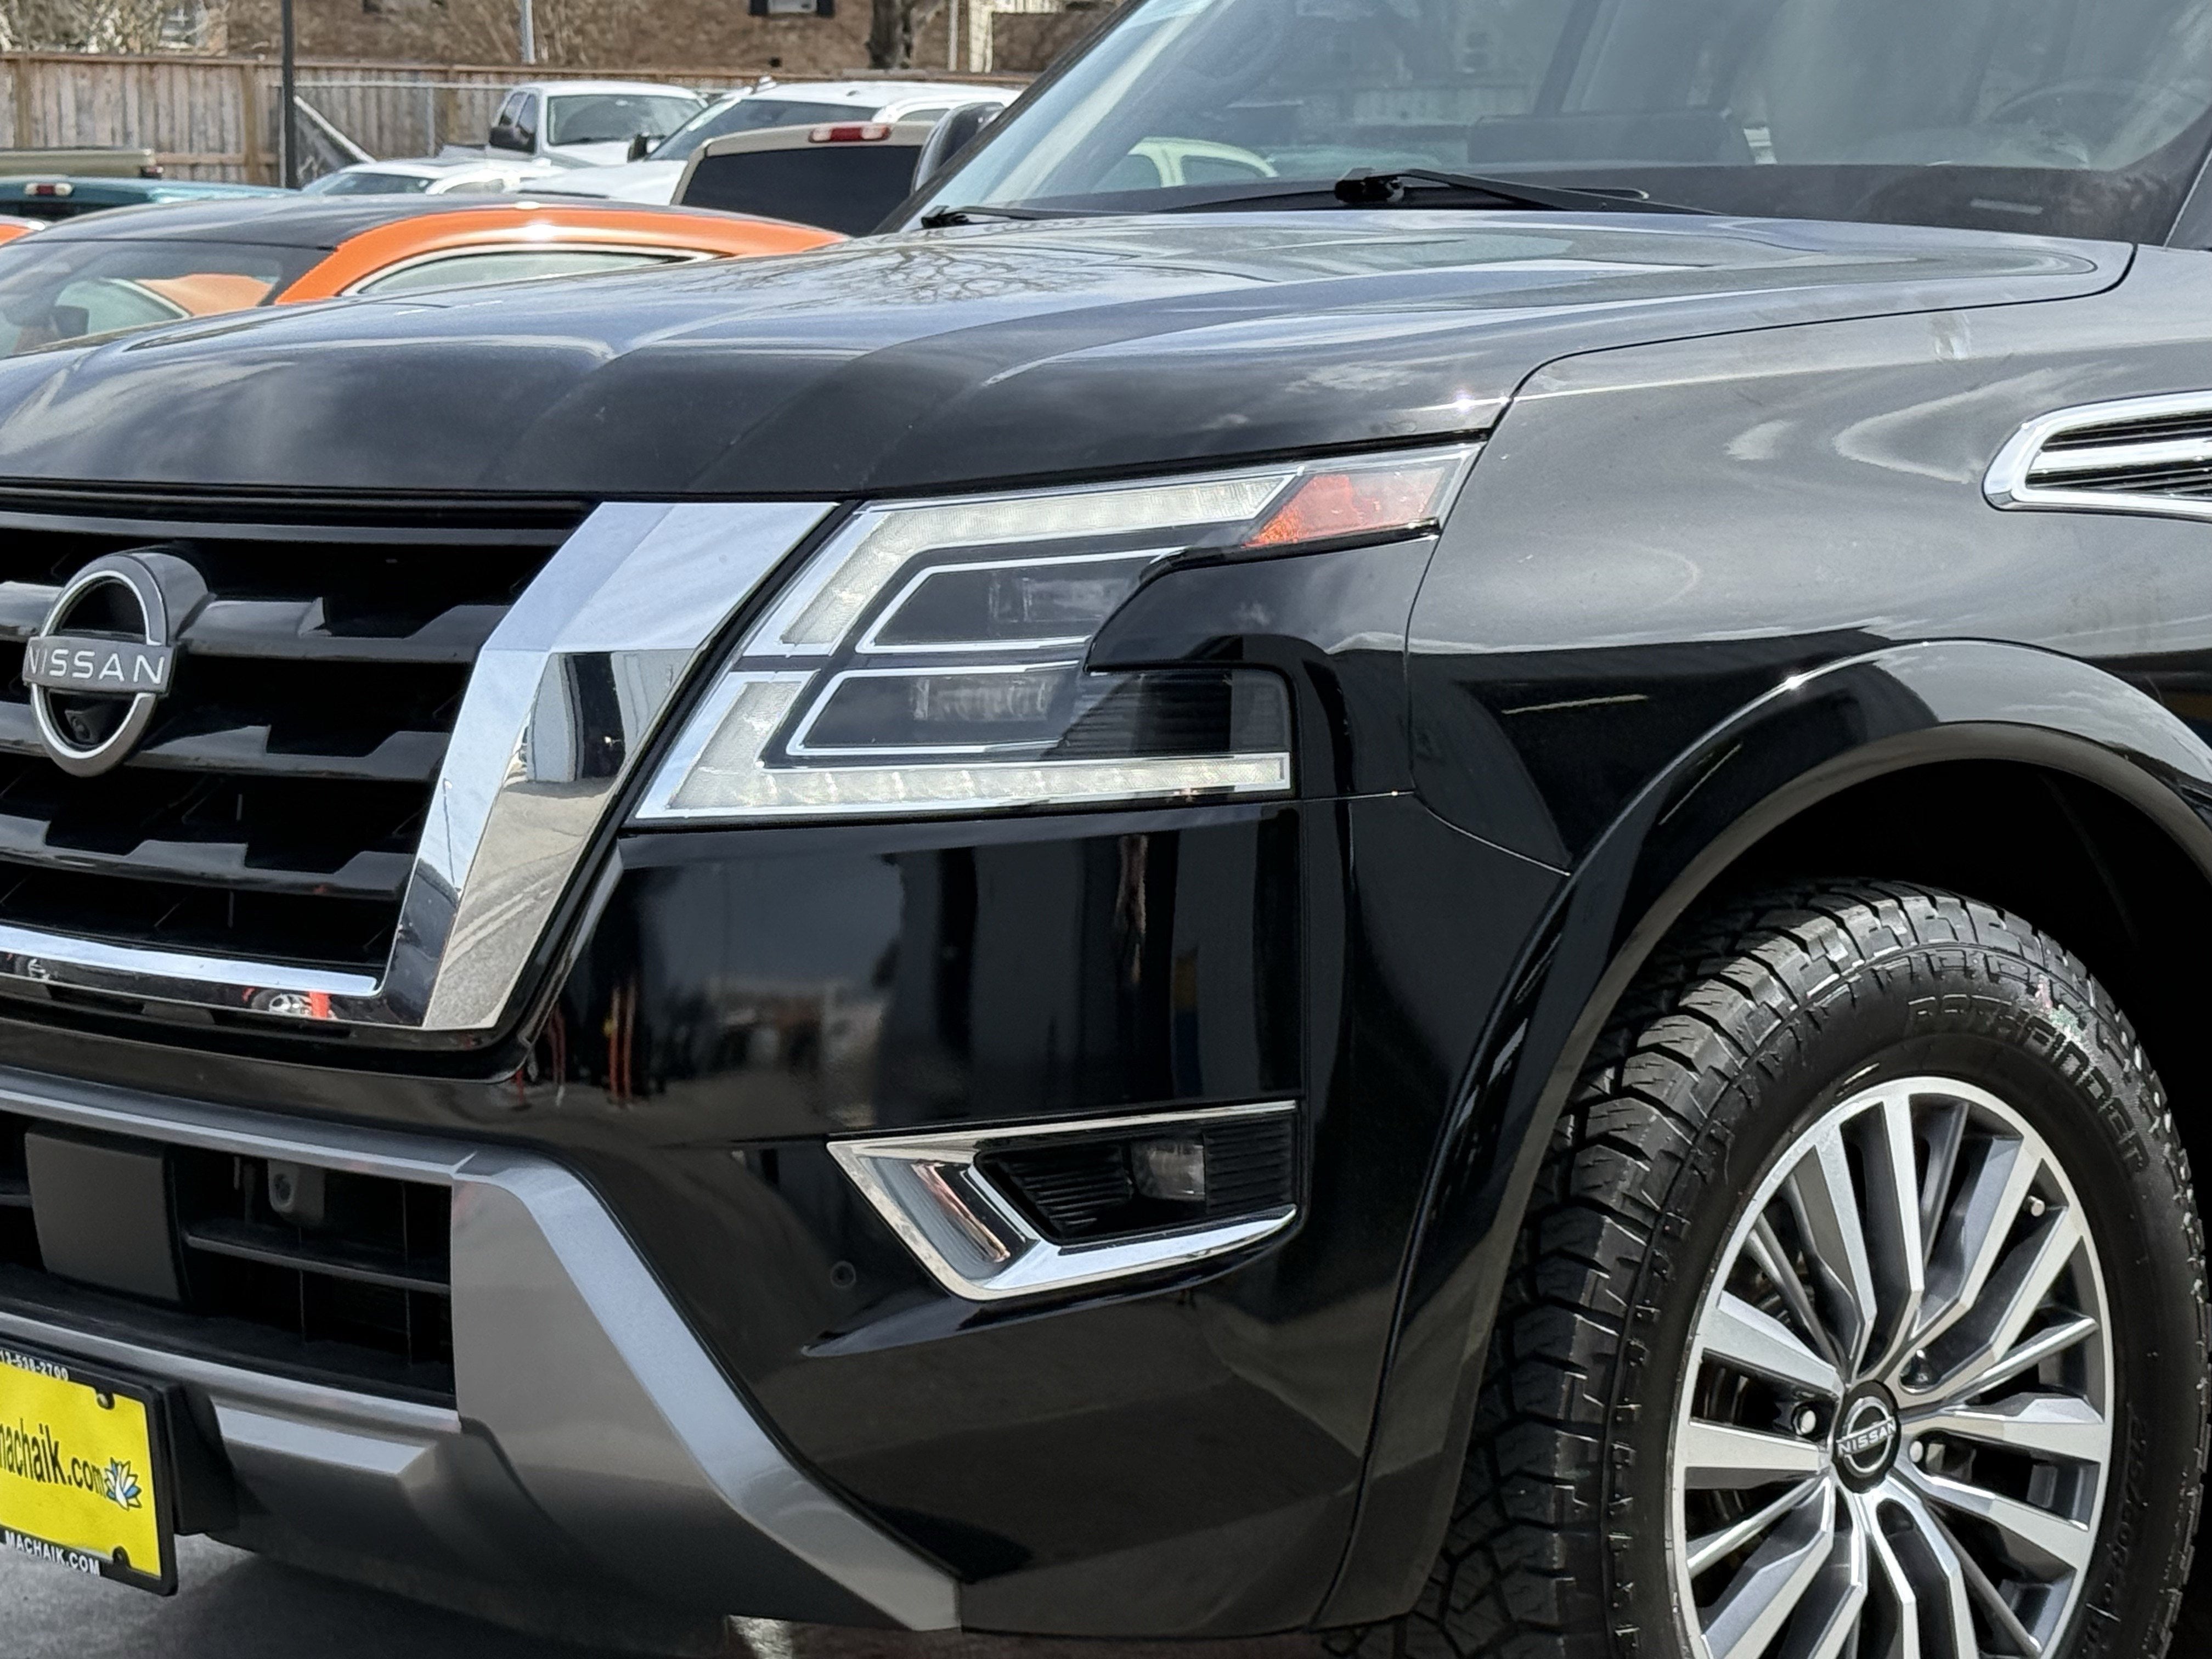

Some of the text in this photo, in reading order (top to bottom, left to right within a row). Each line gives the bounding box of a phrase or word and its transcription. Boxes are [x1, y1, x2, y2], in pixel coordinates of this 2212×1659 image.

[26, 646, 165, 685] NISSAN
[1838, 1422, 1897, 1454] NISSAN
[5, 1530, 101, 1577] MACHAIK.COM
